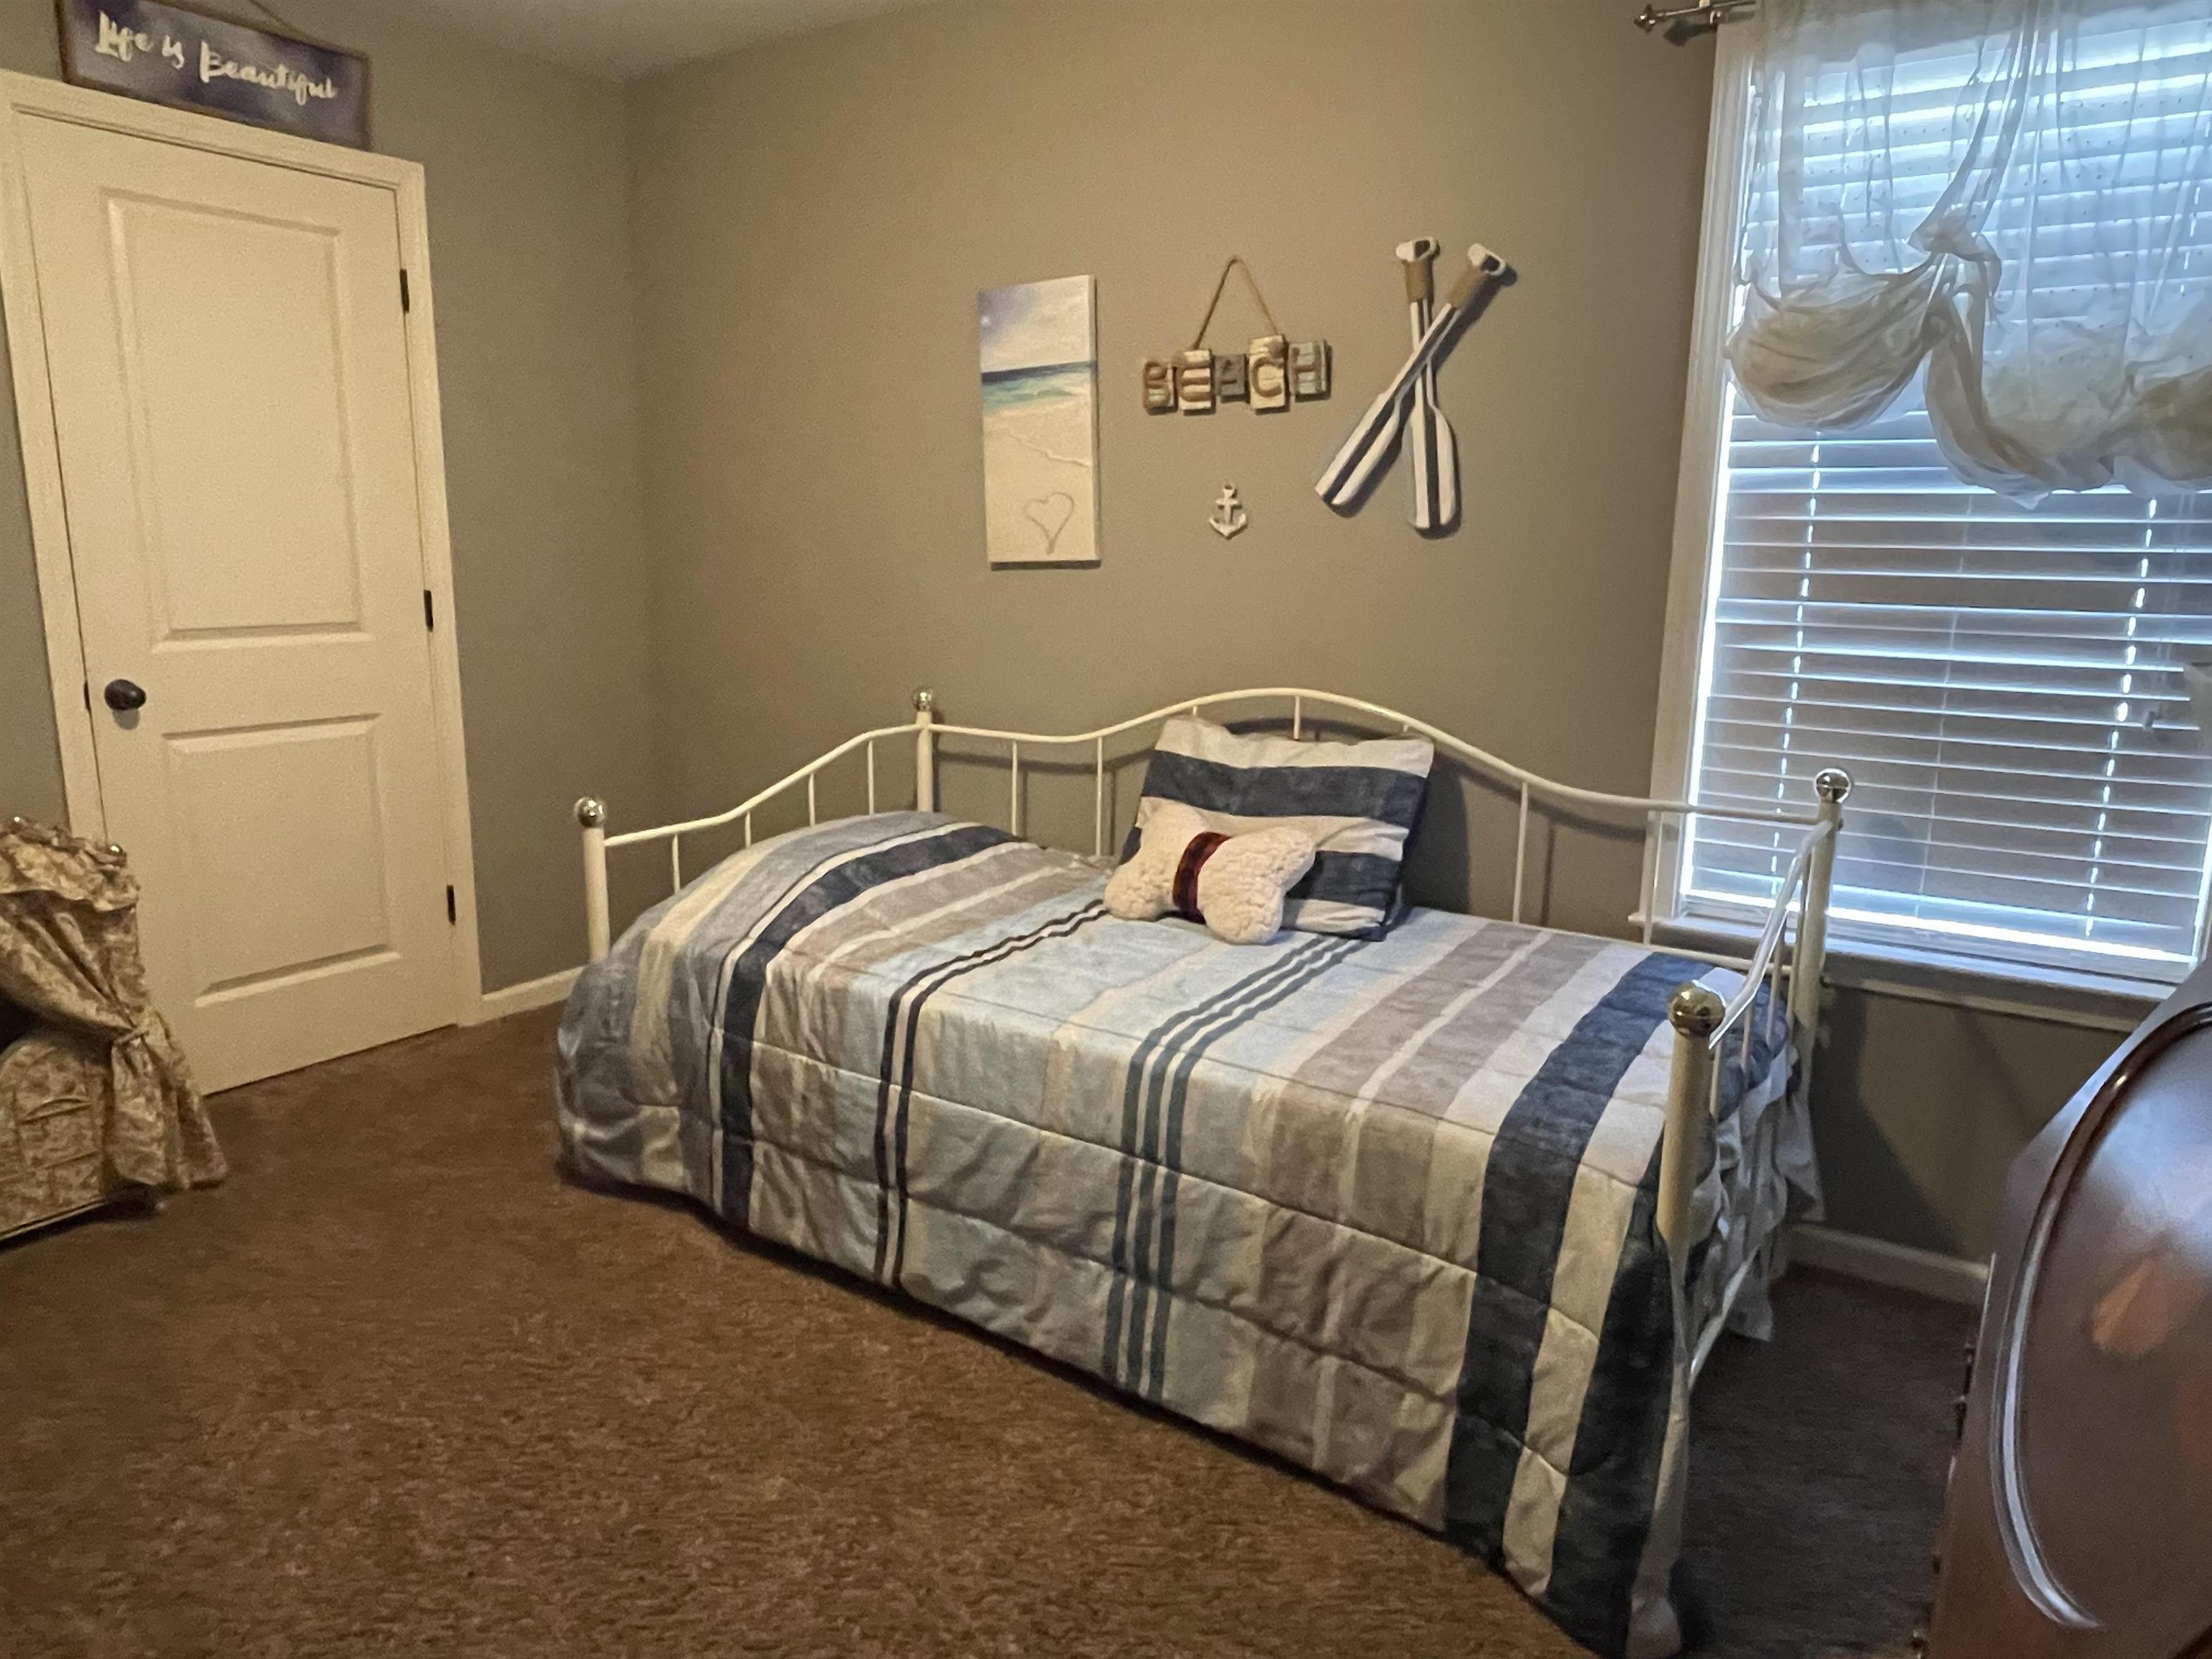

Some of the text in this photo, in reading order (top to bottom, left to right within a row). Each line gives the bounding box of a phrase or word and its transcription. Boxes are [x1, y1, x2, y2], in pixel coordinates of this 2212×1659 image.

[95, 10, 336, 106] Life is Beautiful
[1143, 343, 1323, 408] BEACH
